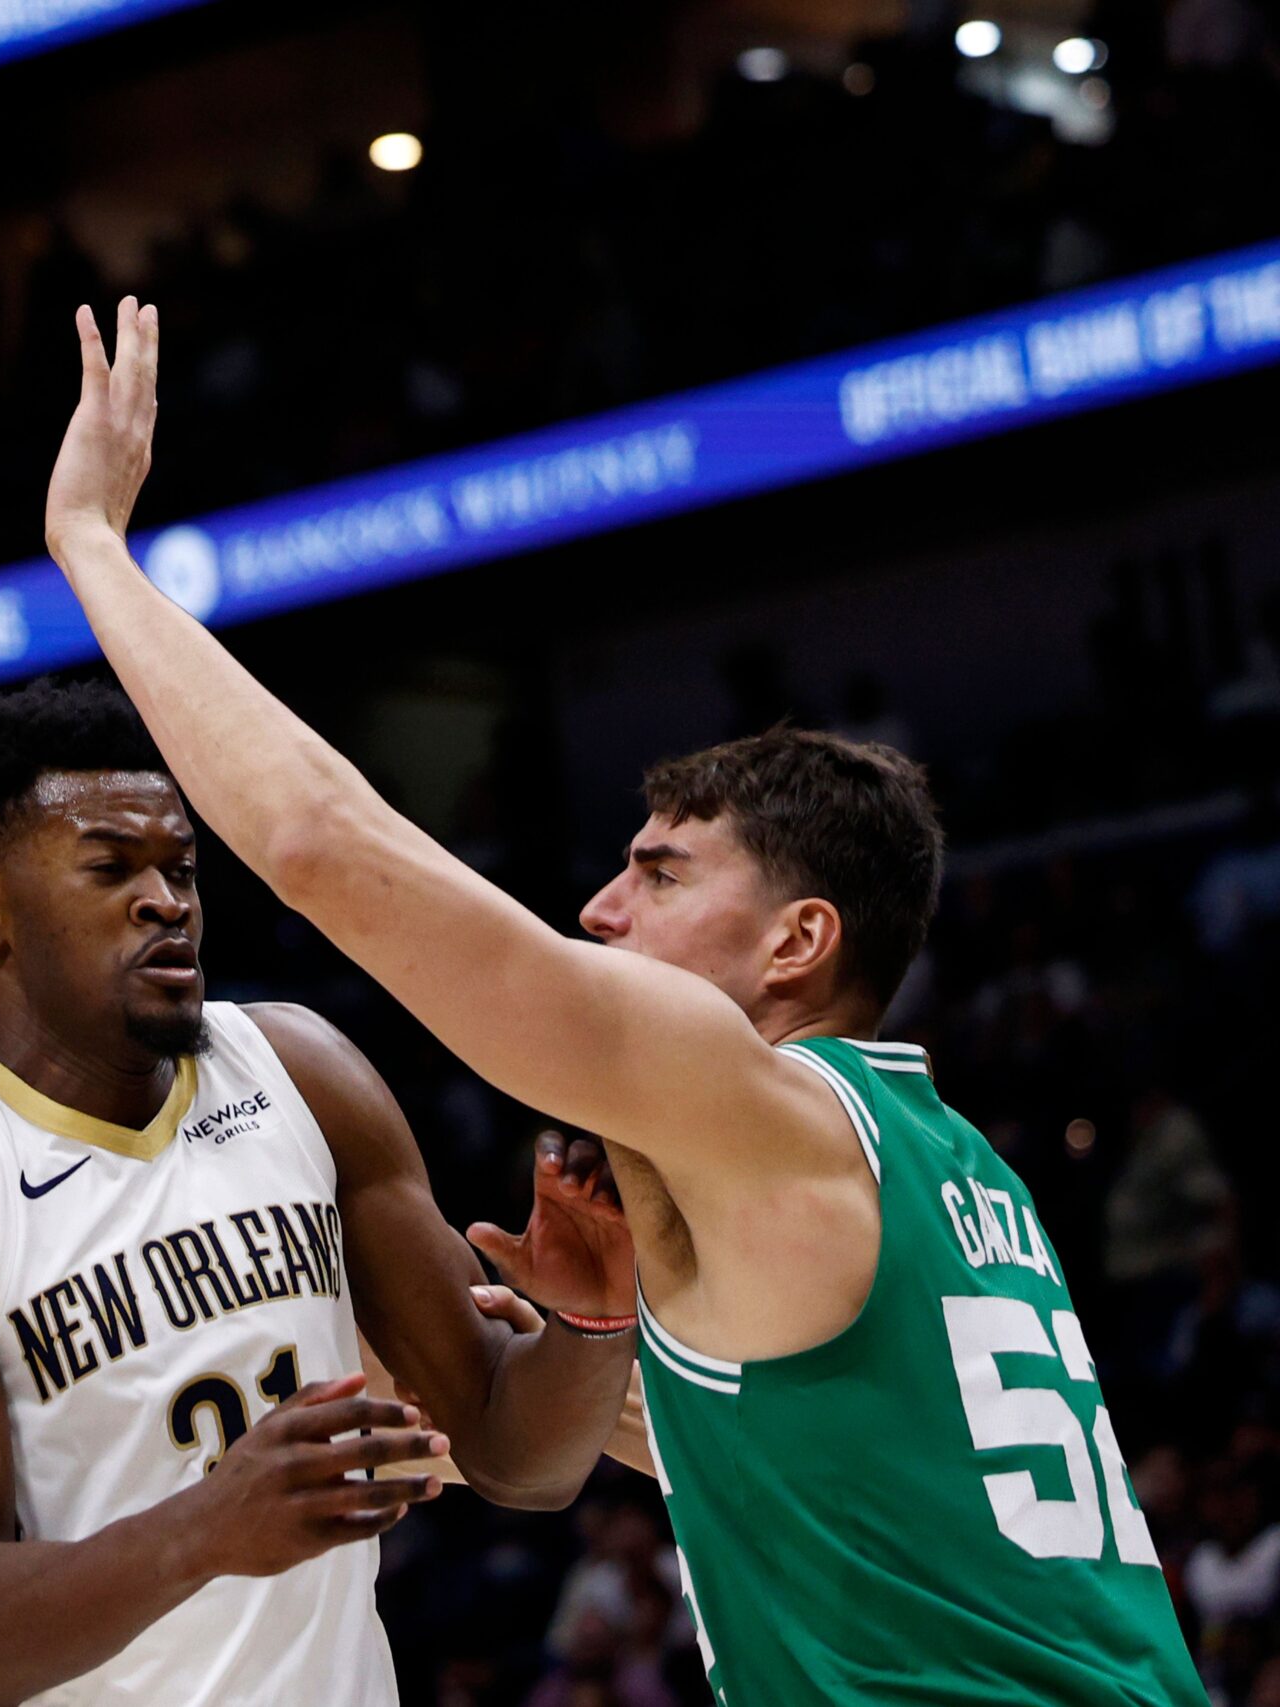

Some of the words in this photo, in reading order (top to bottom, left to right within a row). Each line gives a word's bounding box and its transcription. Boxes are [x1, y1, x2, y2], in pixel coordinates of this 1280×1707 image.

[182, 1091, 272, 1144] NEWAGE
[214, 1119, 261, 1145] GRILLS
[6, 1251, 150, 1405] NEW
[141, 1202, 341, 1332] ORLEANS
[941, 1295, 1162, 1569] 52
